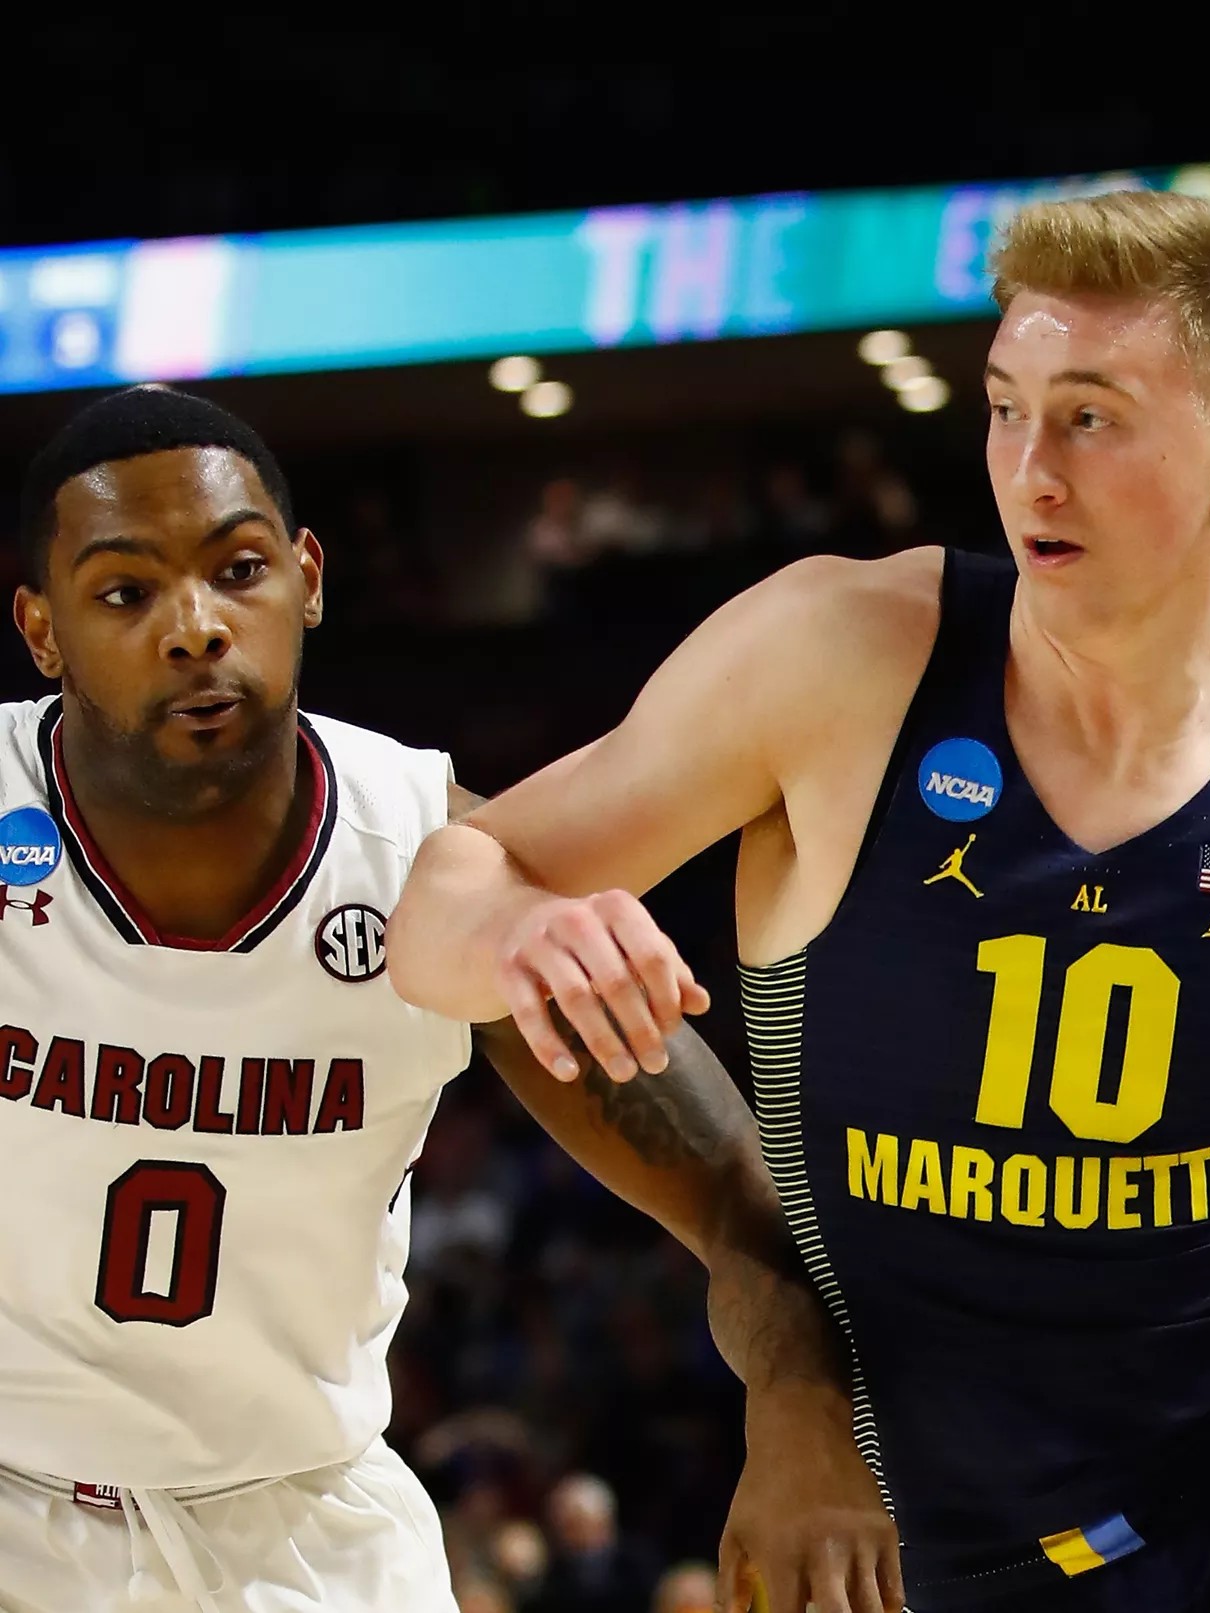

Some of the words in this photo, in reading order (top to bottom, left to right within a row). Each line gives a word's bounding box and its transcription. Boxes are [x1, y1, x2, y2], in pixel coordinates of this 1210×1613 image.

[575, 192, 806, 348] THE
[925, 770, 995, 808] NCAA
[0, 845, 56, 866] NCAA
[1070, 883, 1108, 914] AL
[321, 908, 387, 977] SEC
[0, 1023, 365, 1136] CAROLINA
[974, 933, 1182, 1144] 10
[94, 1158, 228, 1329] 0
